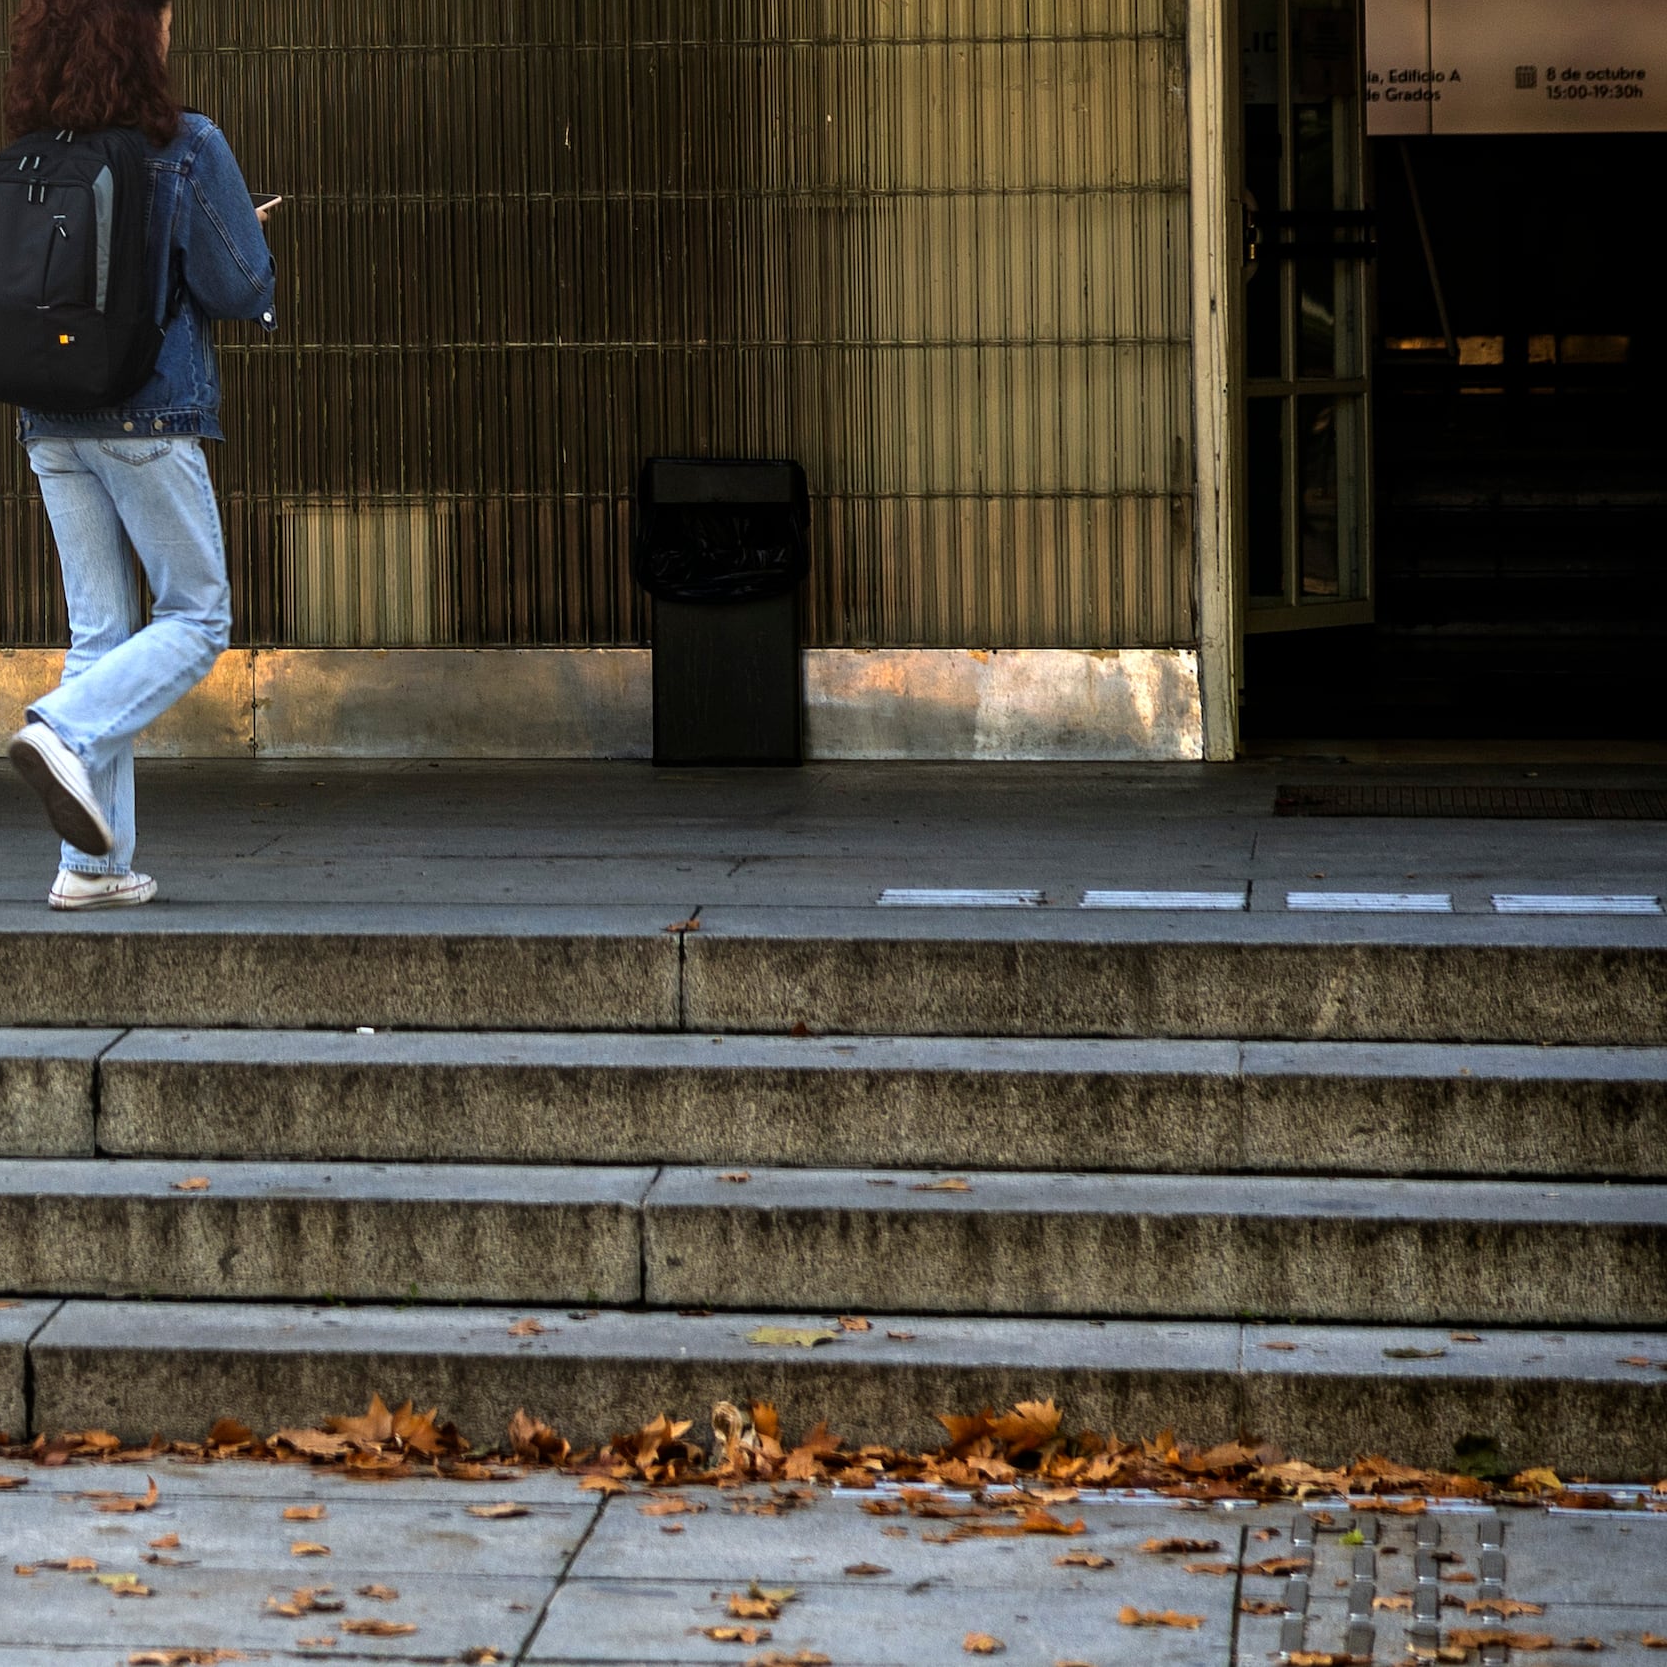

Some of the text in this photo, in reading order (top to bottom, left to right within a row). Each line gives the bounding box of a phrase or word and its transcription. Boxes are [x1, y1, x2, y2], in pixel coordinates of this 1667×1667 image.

[1389, 68, 1445, 83] Edificio
[1450, 68, 1461, 82] A
[1546, 66, 1646, 80] 8 de octubre
[1386, 86, 1441, 102] Grados
[1546, 84, 1643, 99] 15:00-19:30h
